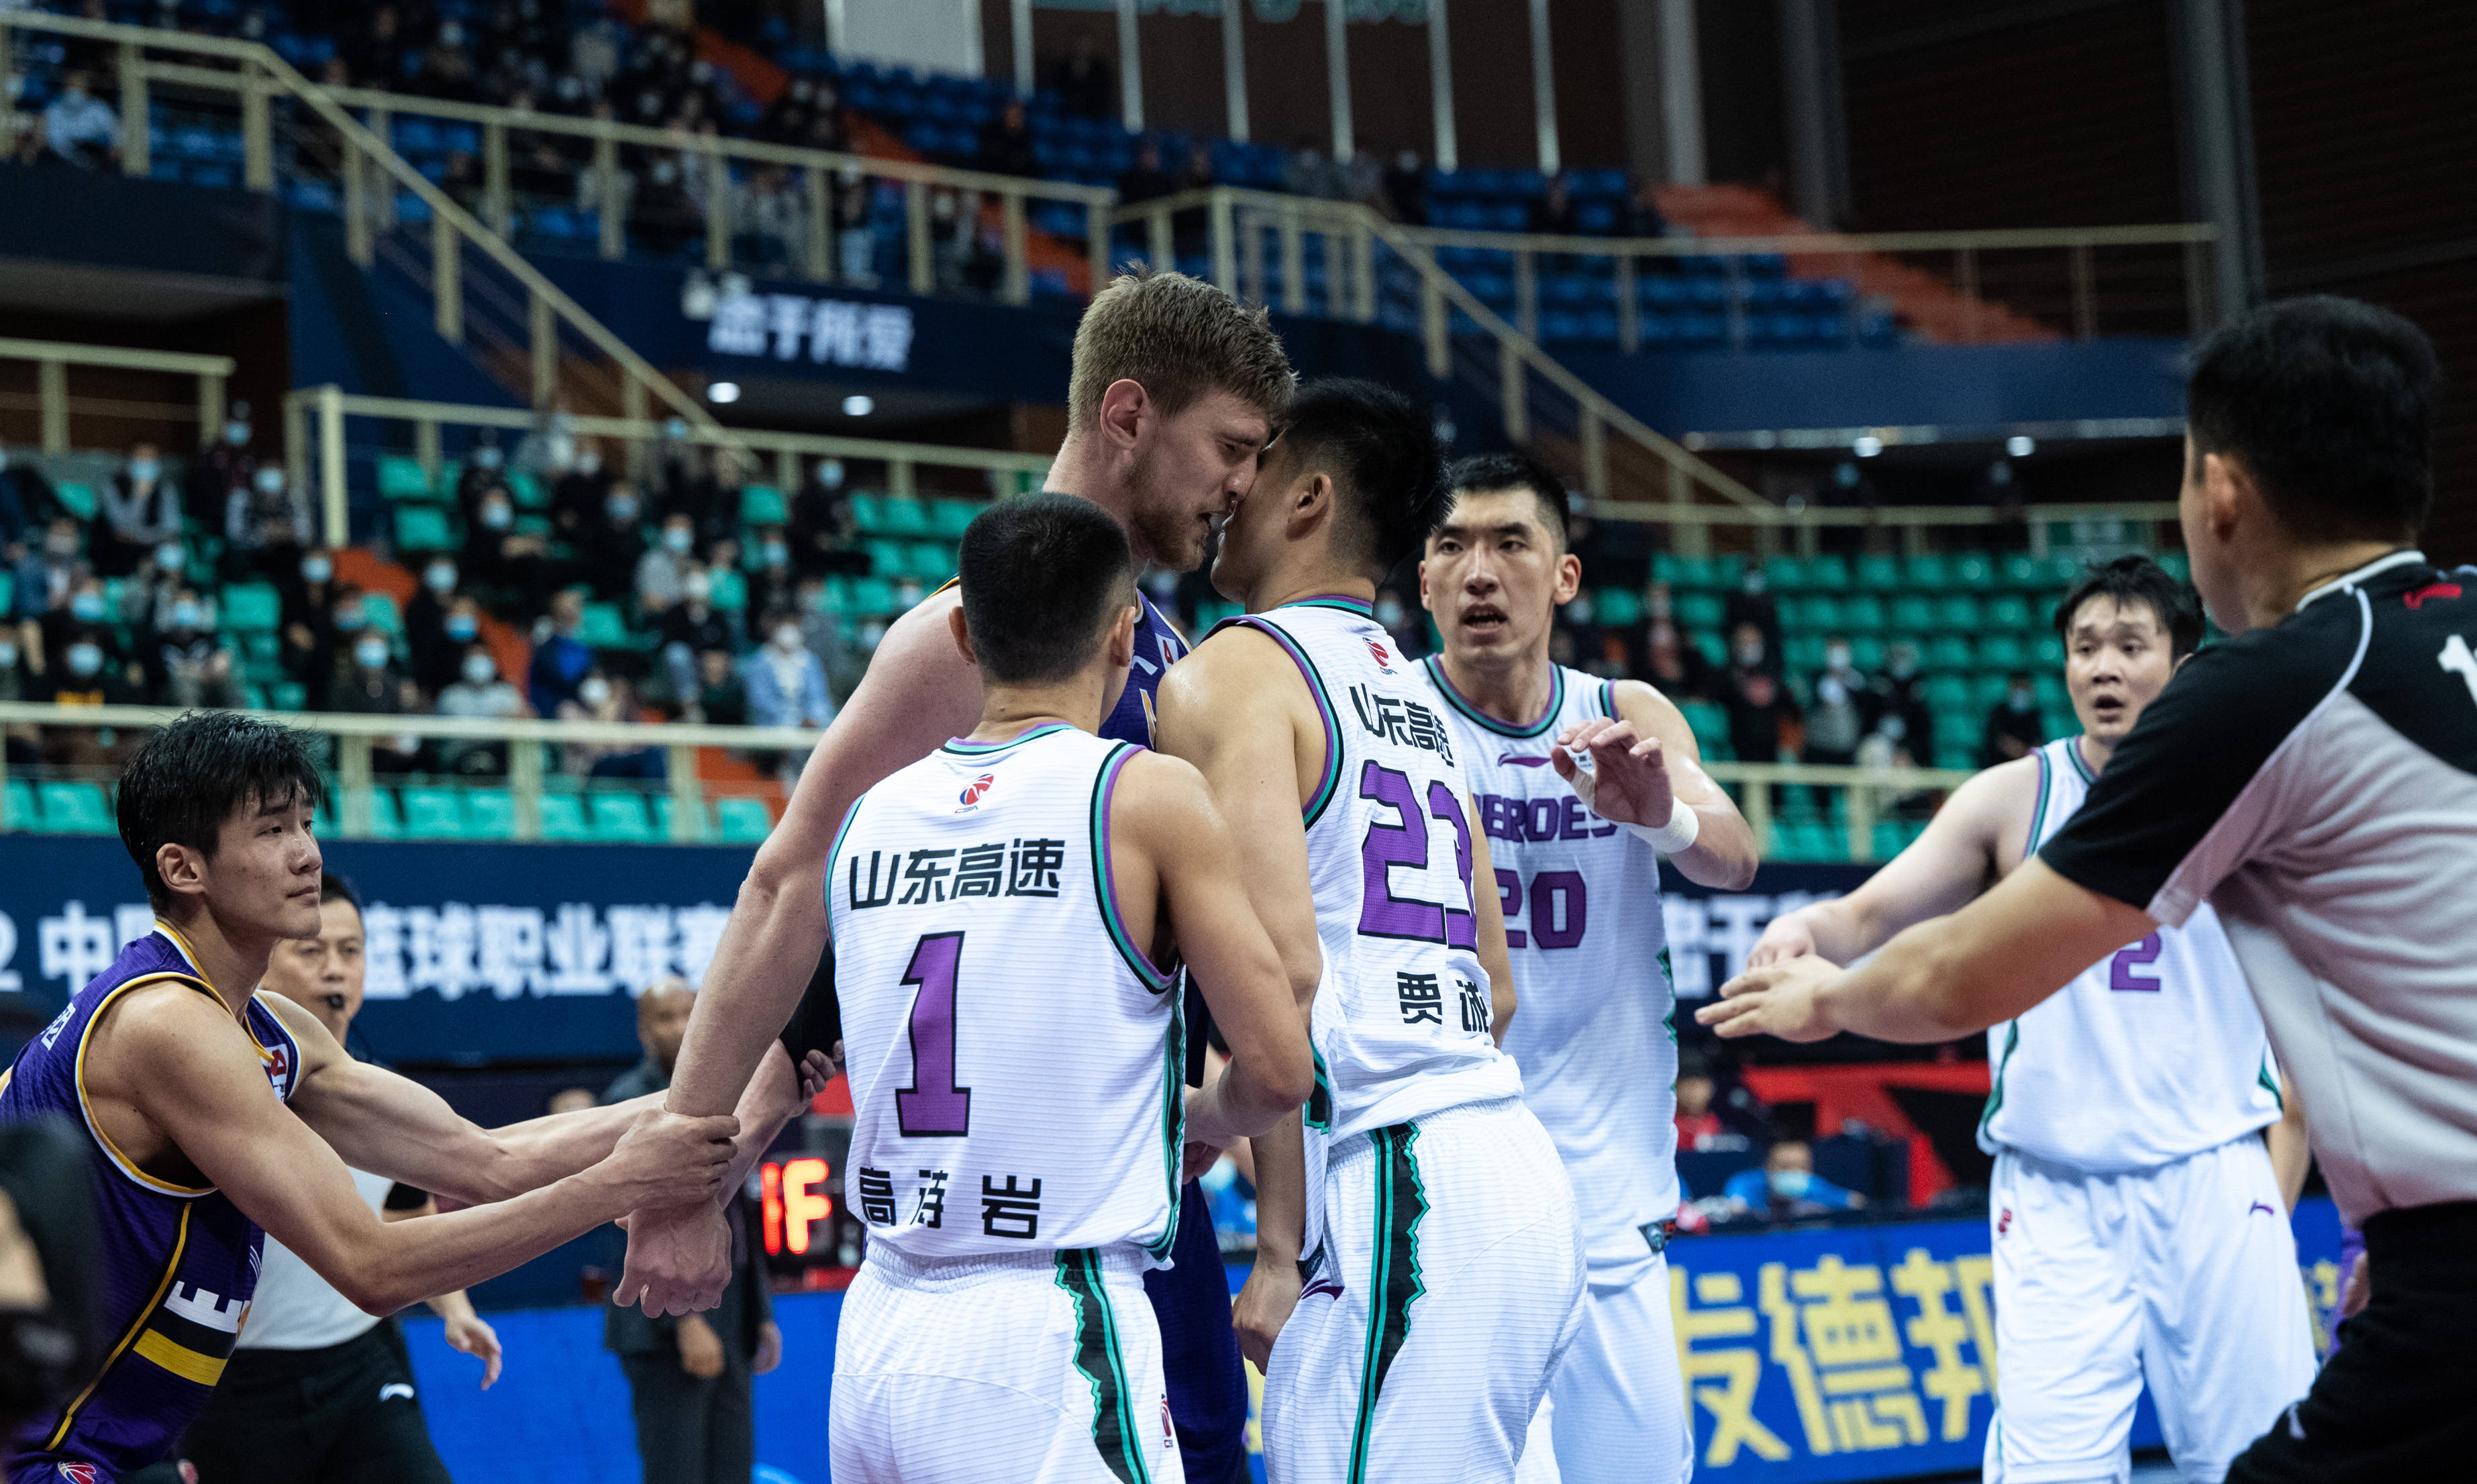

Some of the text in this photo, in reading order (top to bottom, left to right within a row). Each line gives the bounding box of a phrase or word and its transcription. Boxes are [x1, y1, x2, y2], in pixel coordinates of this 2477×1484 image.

[1349, 683, 1454, 767] 山东高速
[1358, 759, 1478, 957] 23
[1472, 793, 1618, 843] EROES
[850, 837, 1066, 911] 山东高速
[1493, 867, 1586, 949] 20
[2111, 932, 2162, 992] 2
[895, 931, 971, 1137] 1
